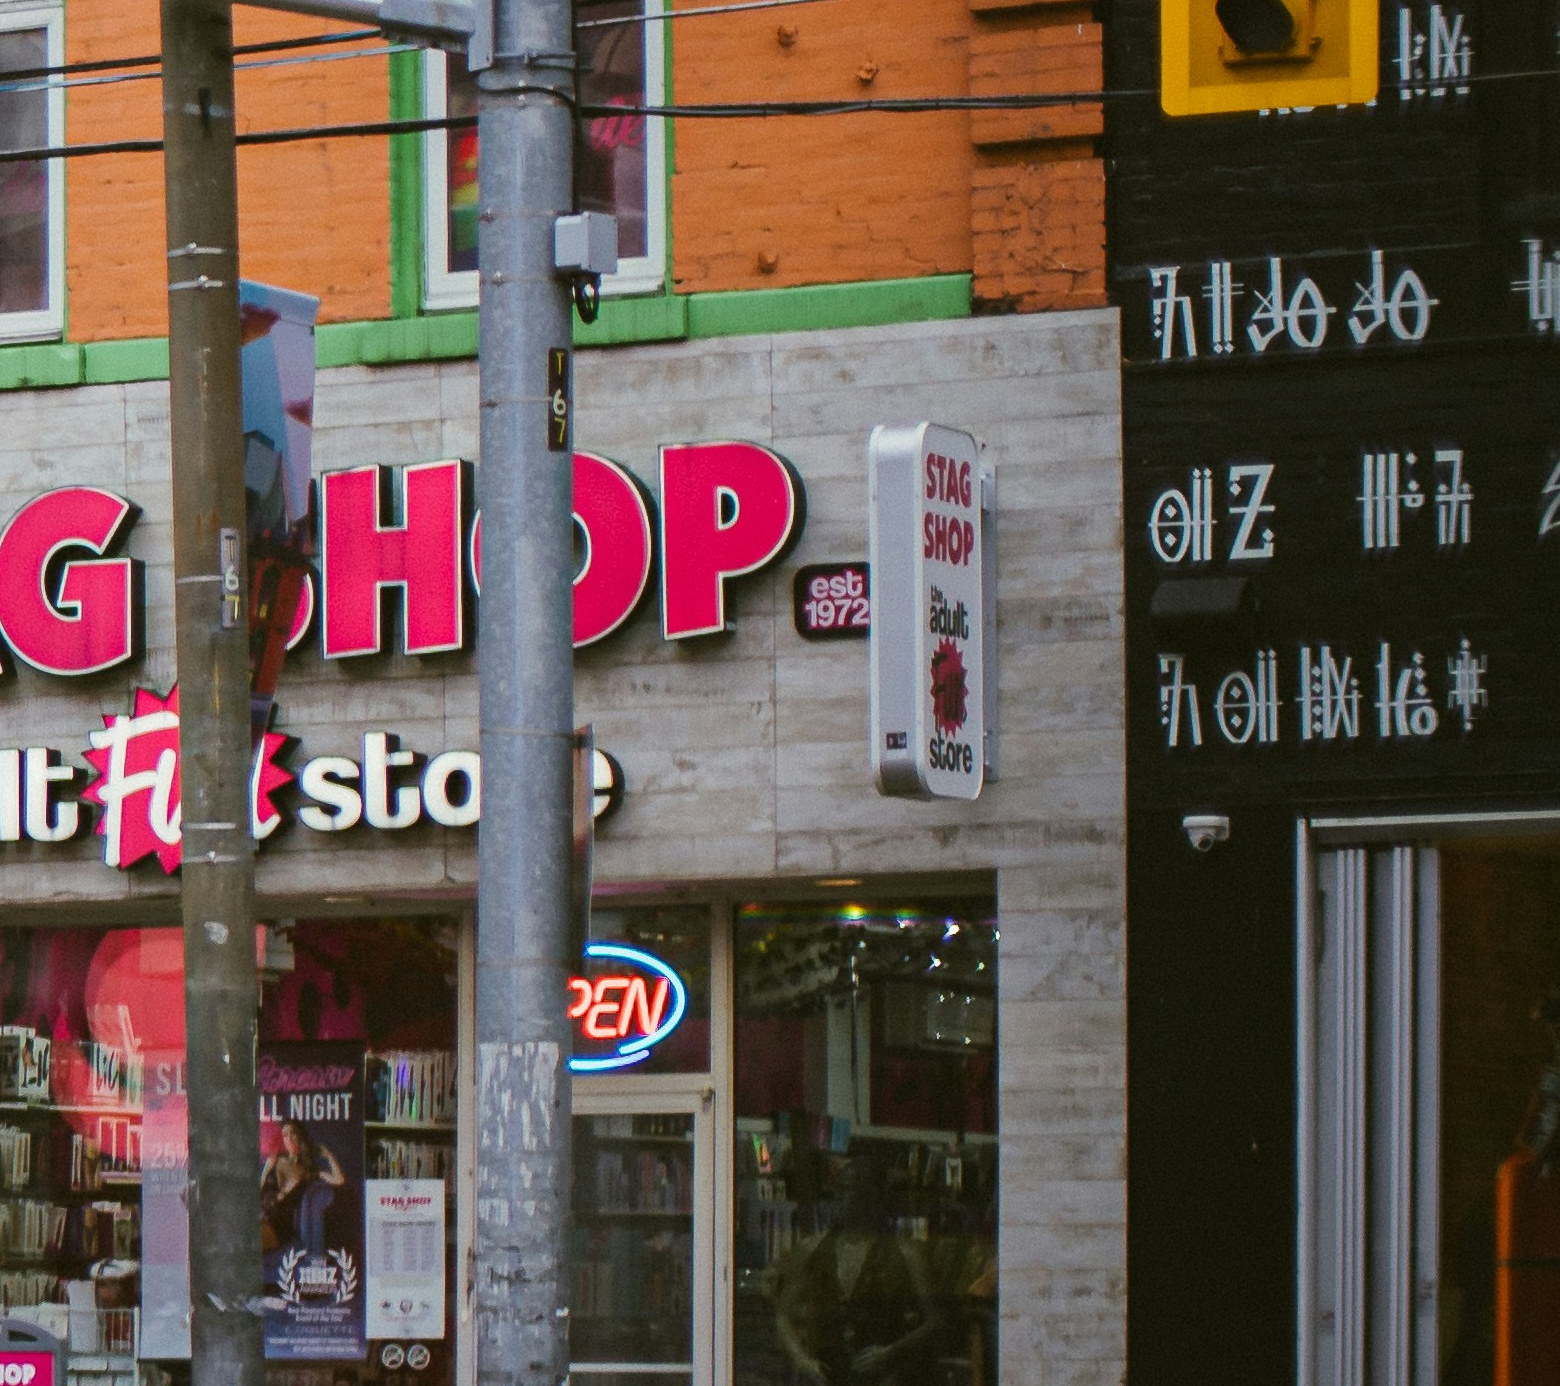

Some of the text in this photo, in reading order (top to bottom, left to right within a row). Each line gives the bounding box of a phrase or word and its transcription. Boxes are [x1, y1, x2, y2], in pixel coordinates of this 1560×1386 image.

[552, 351, 567, 443] T67
[926, 453, 972, 508] STAG
[923, 512, 975, 566] SHOP
[223, 533, 240, 621] T67
[810, 570, 864, 598] est
[805, 599, 871, 629] 1972
[929, 600, 970, 640] adult
[929, 734, 973, 774] store
[297, 731, 618, 831] stoe
[289, 1092, 353, 1121] NIGHT
